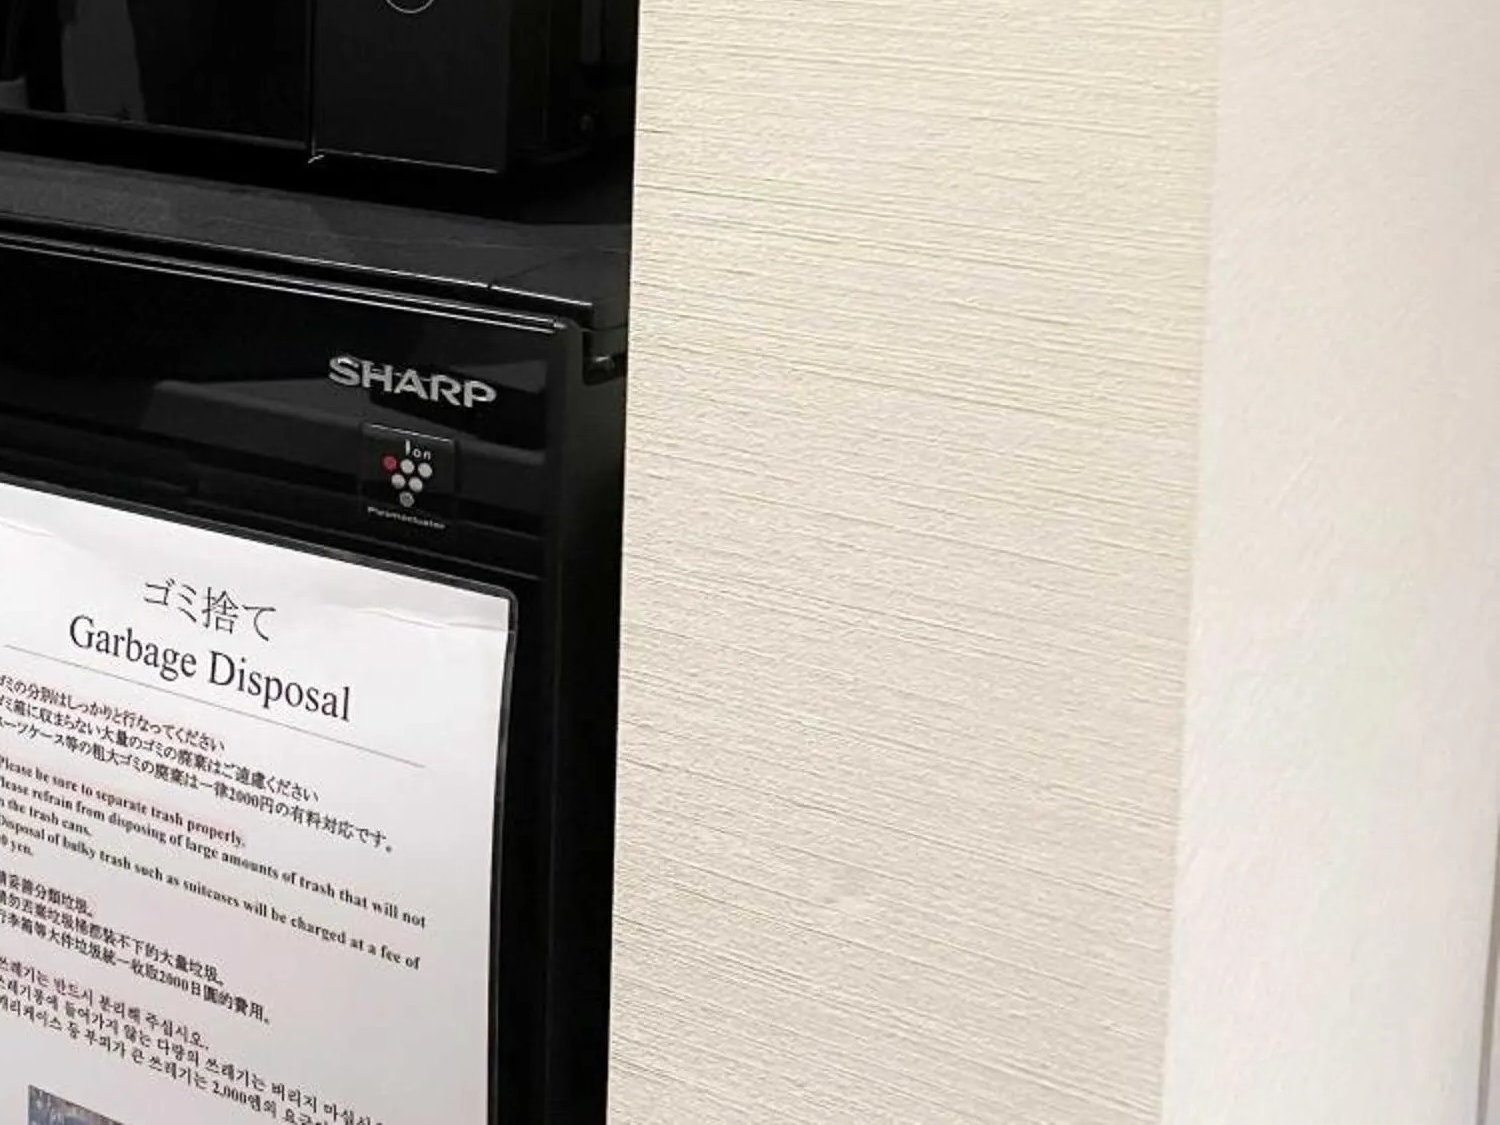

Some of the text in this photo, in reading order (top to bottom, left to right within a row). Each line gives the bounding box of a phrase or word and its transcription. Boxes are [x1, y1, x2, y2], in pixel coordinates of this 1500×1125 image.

[328, 355, 497, 409] SHARP
[404, 439, 431, 460] Ion
[142, 577, 277, 642] ゴミ捨て
[69, 615, 351, 722] Garbage Disposal
[6, 797, 26, 814] the
[28, 804, 59, 826] trash
[60, 819, 92, 837] cans.
[34, 765, 49, 784] be
[51, 775, 78, 792] sure
[80, 782, 93, 796] to
[94, 789, 148, 816] separate
[150, 805, 183, 827] trash
[186, 818, 245, 848] properly.
[31, 788, 73, 811] refrain
[74, 799, 105, 822] from
[107, 811, 167, 845] disposing
[168, 833, 182, 847] of
[184, 835, 219, 860] large
[220, 851, 279, 880] amounts
[281, 871, 297, 885] of
[298, 875, 335, 899] trash
[338, 888, 367, 910] that
[370, 901, 399, 920] will
[401, 911, 425, 929] not
[46, 832, 60, 846] of
[61, 834, 96, 860] bulky
[98, 849, 131, 870] trash
[133, 863, 163, 882] such
[165, 874, 180, 886] as
[182, 879, 239, 908] suitcases
[242, 900, 267, 918] will
[270, 906, 287, 924] be
[289, 915, 346, 945] charged
[349, 938, 364, 951] at
[367, 943, 377, 956] a
[380, 943, 401, 964] fee
[404, 955, 420, 970] of
[52, 976, 93, 1008] 반드시
[147, 1054, 208, 1090] 쓰레기는
[156, 1037, 199, 1068] 다량의
[203, 1057, 266, 1092] 쓰레기는
[270, 1082, 317, 1114] 버리지
[323, 1103, 384, 1125] 마십시
